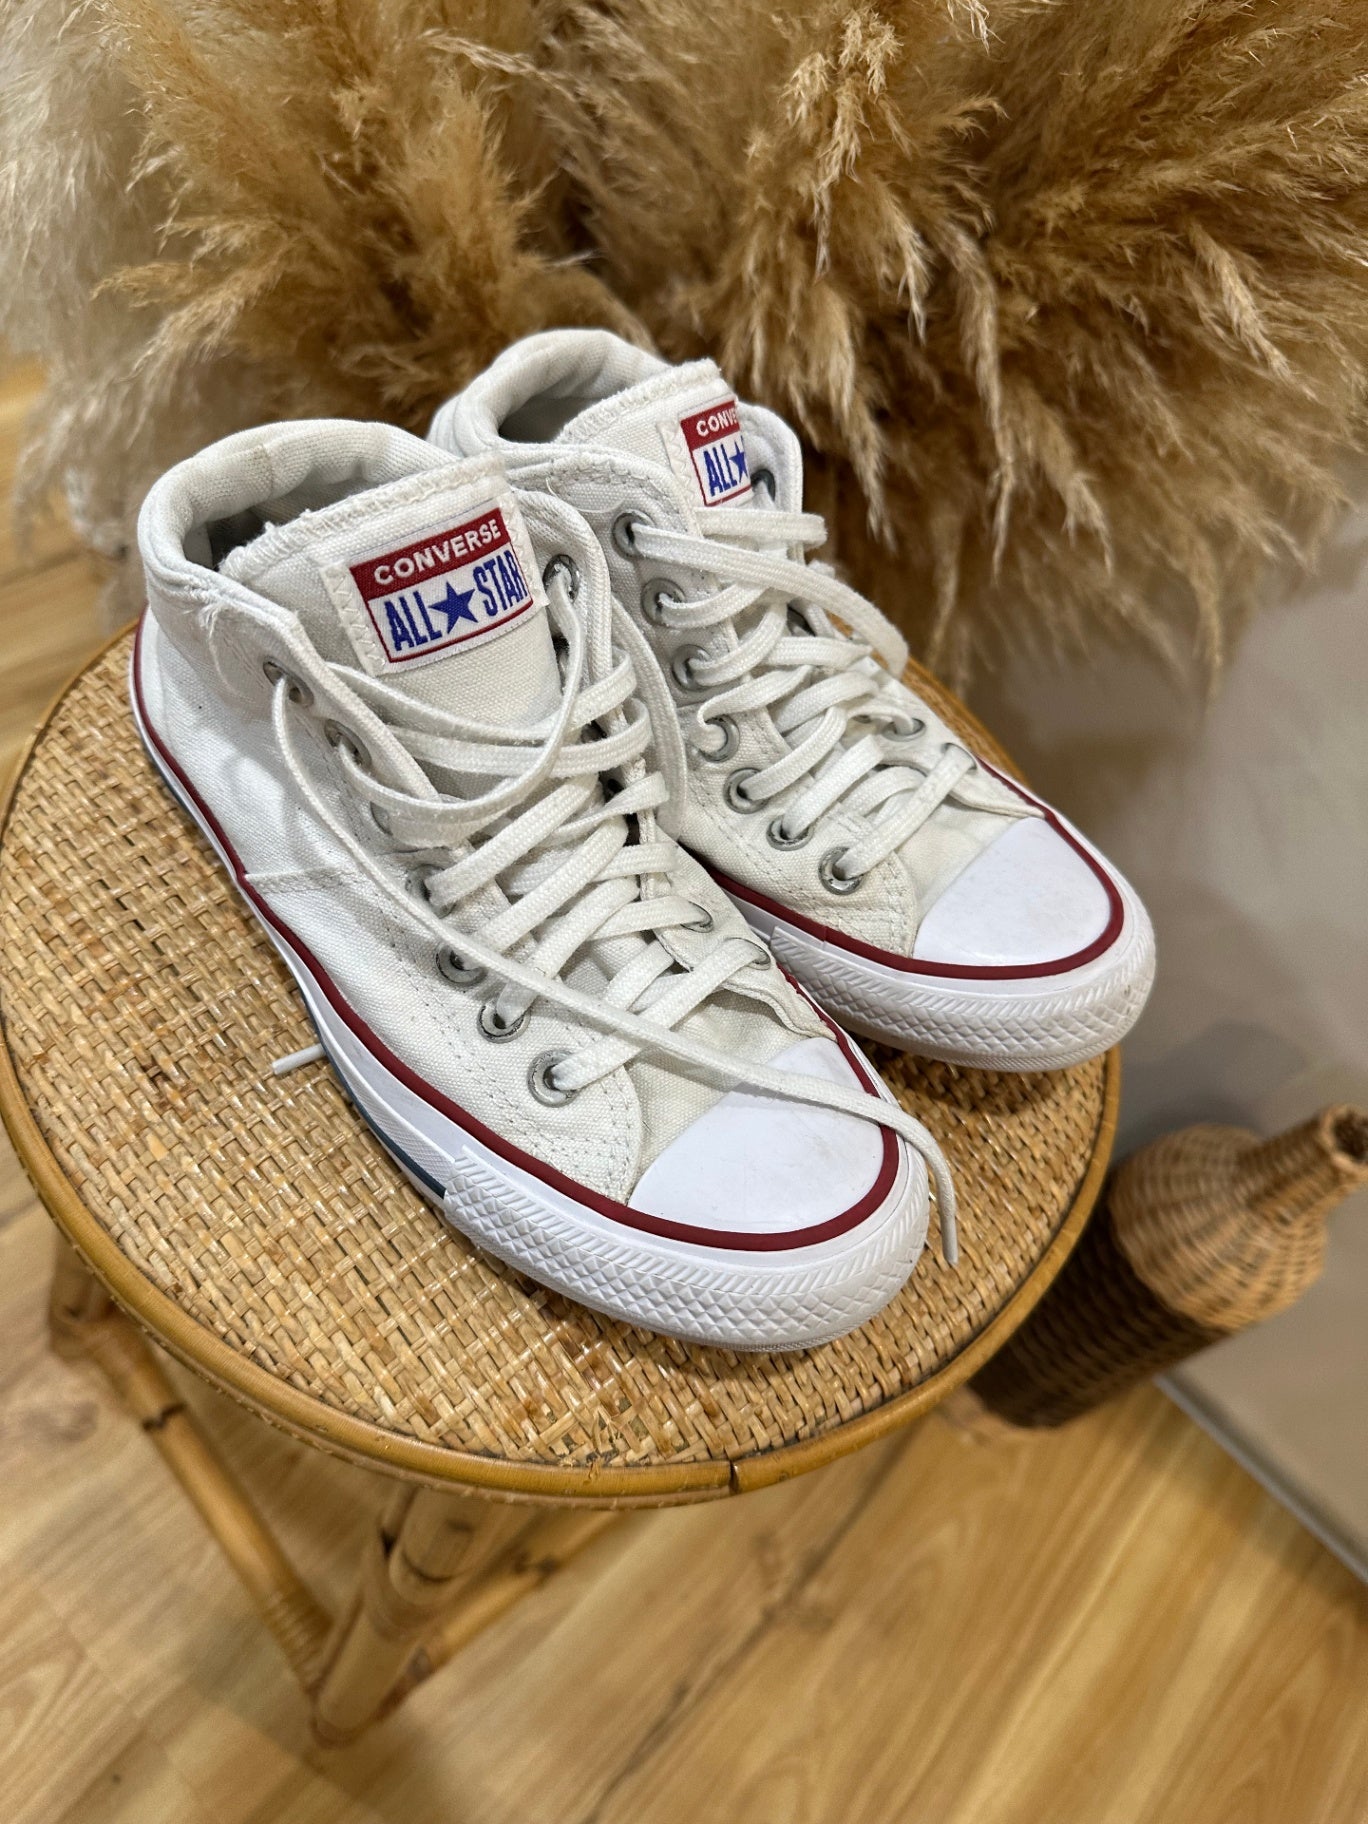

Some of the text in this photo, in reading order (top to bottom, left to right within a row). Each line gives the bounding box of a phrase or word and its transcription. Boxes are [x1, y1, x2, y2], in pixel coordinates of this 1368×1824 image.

[703, 443, 738, 497] ALL
[373, 519, 501, 585] CONVERSE
[384, 550, 528, 651] ALL STAR
